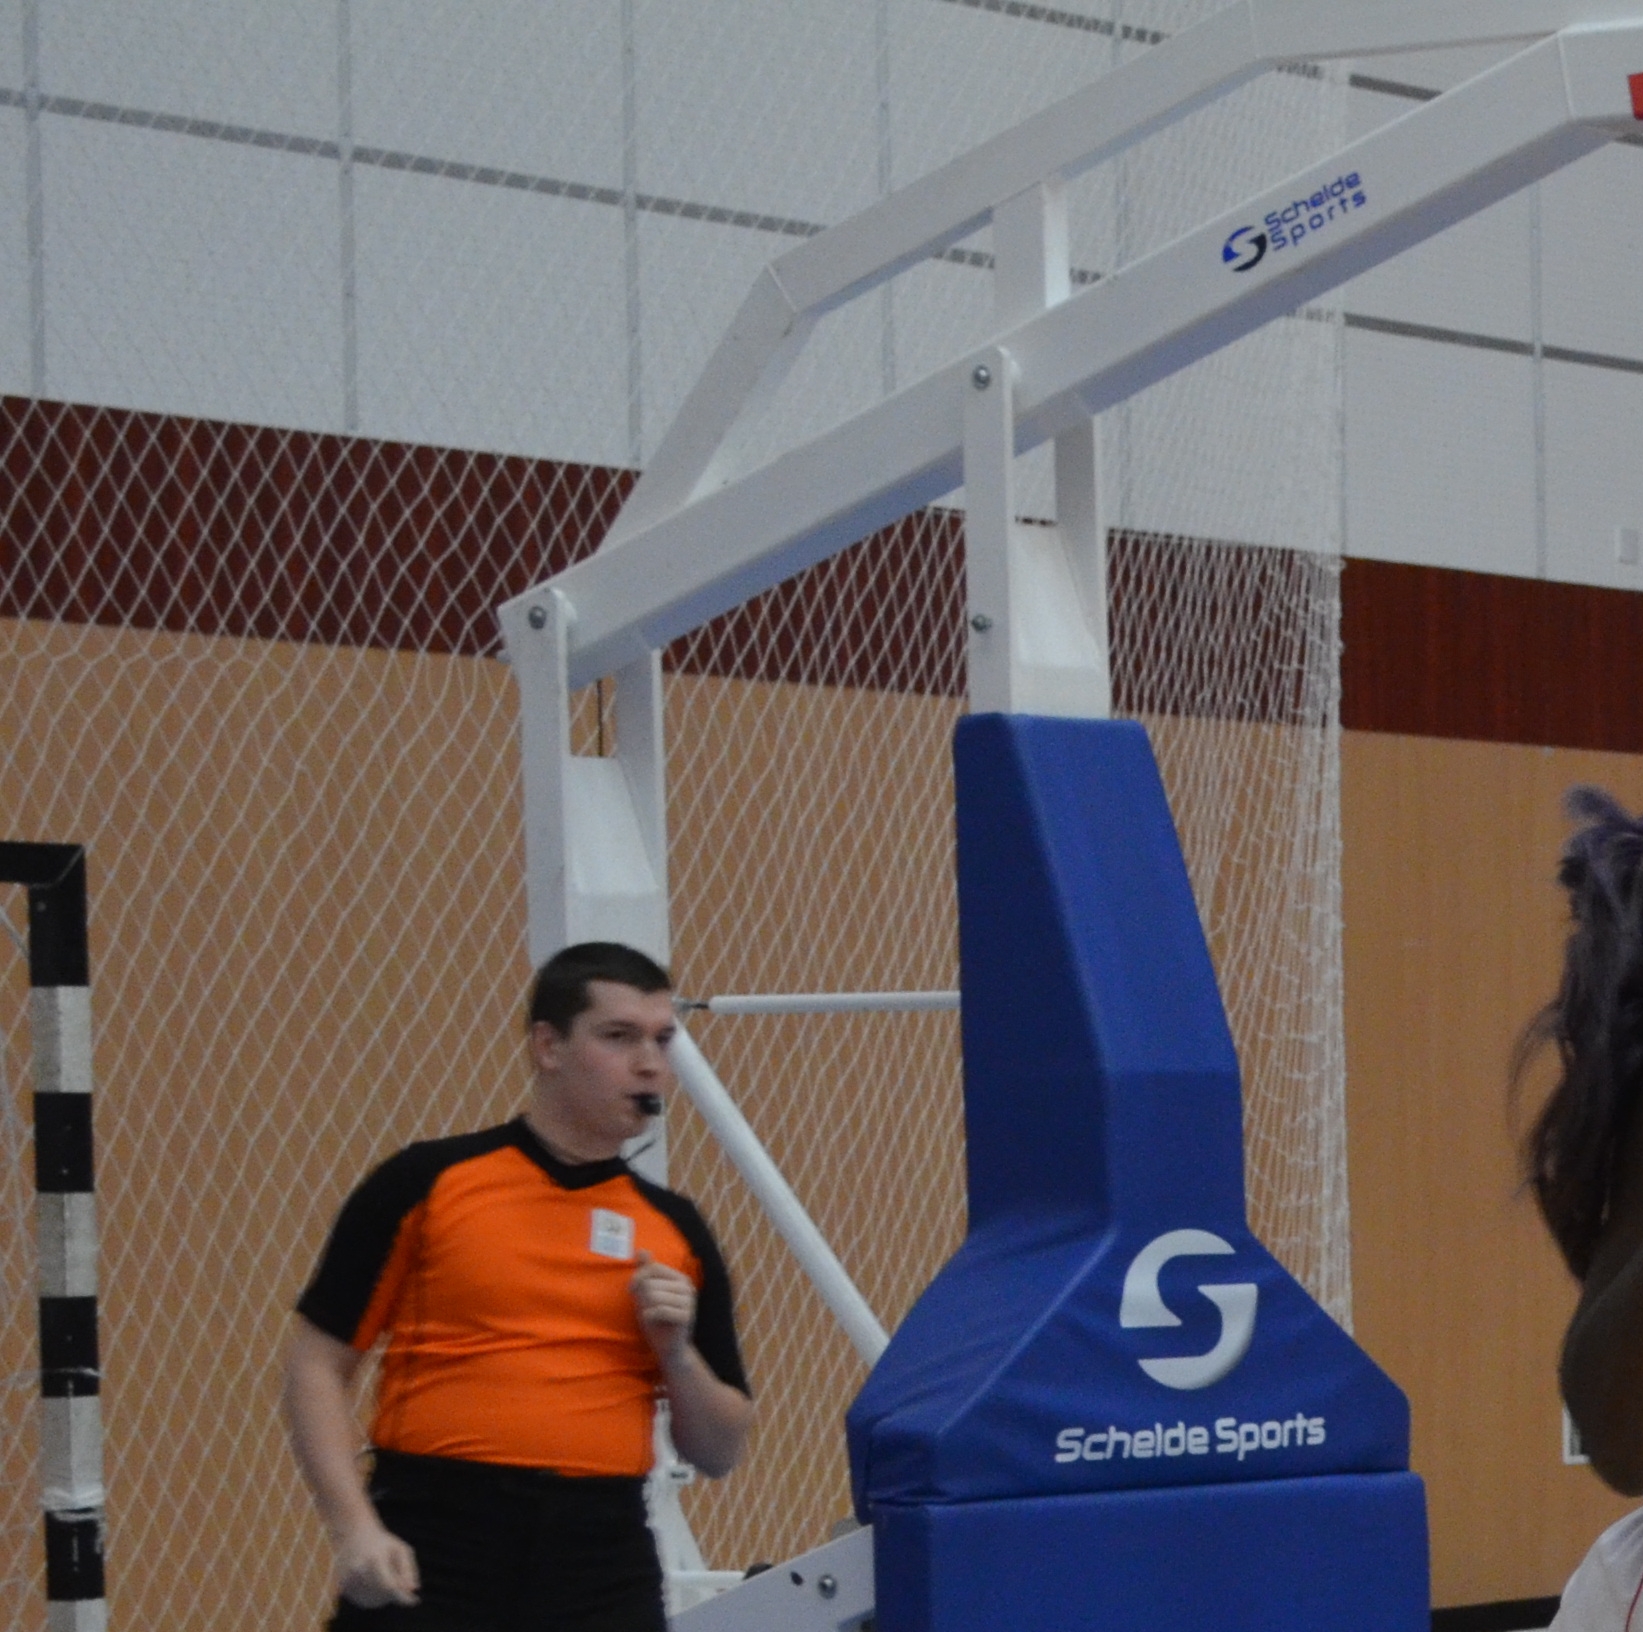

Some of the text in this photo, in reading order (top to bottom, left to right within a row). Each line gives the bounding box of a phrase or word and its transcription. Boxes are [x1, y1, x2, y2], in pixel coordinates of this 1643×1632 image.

[1264, 172, 1361, 233] Schelde
[1269, 190, 1367, 251] Sports
[1054, 1411, 1327, 1463] Schelde Sports
